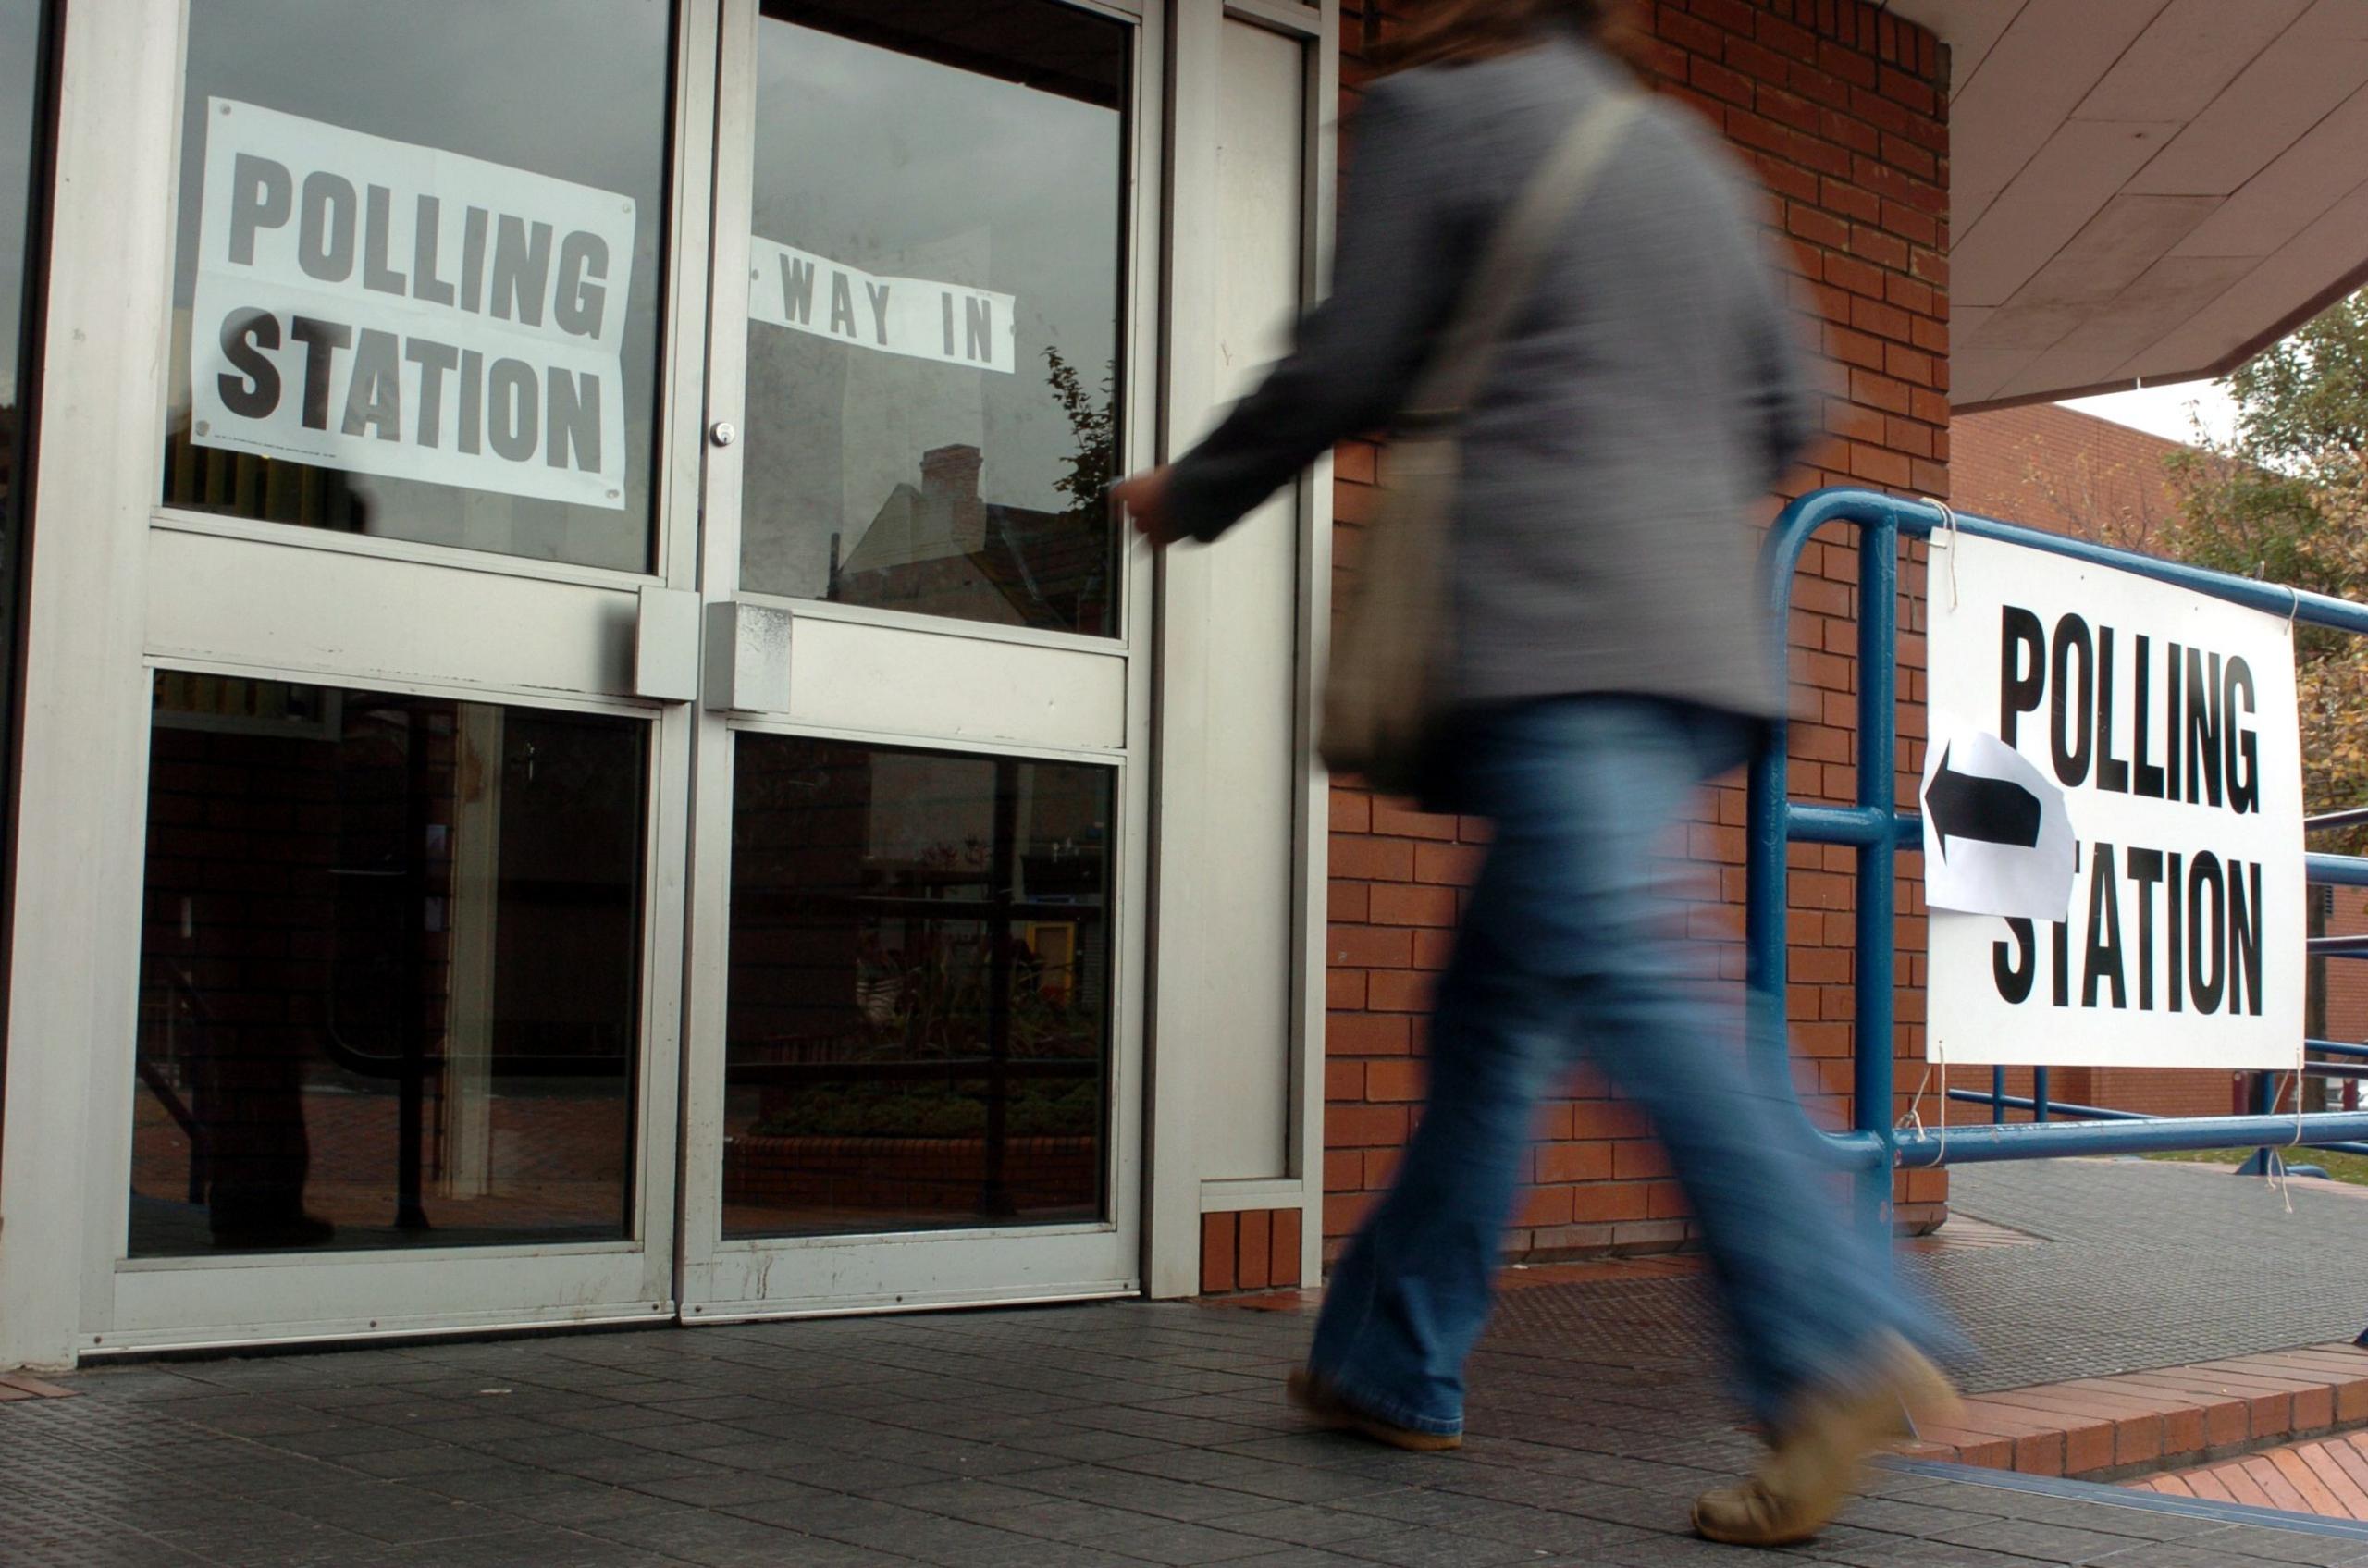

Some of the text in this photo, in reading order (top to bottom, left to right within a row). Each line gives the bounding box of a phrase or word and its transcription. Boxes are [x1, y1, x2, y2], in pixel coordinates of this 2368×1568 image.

[228, 152, 610, 340] POLLING
[779, 253, 992, 364] WAY IN
[217, 306, 602, 475] STATION
[2001, 604, 2260, 815] POLLING
